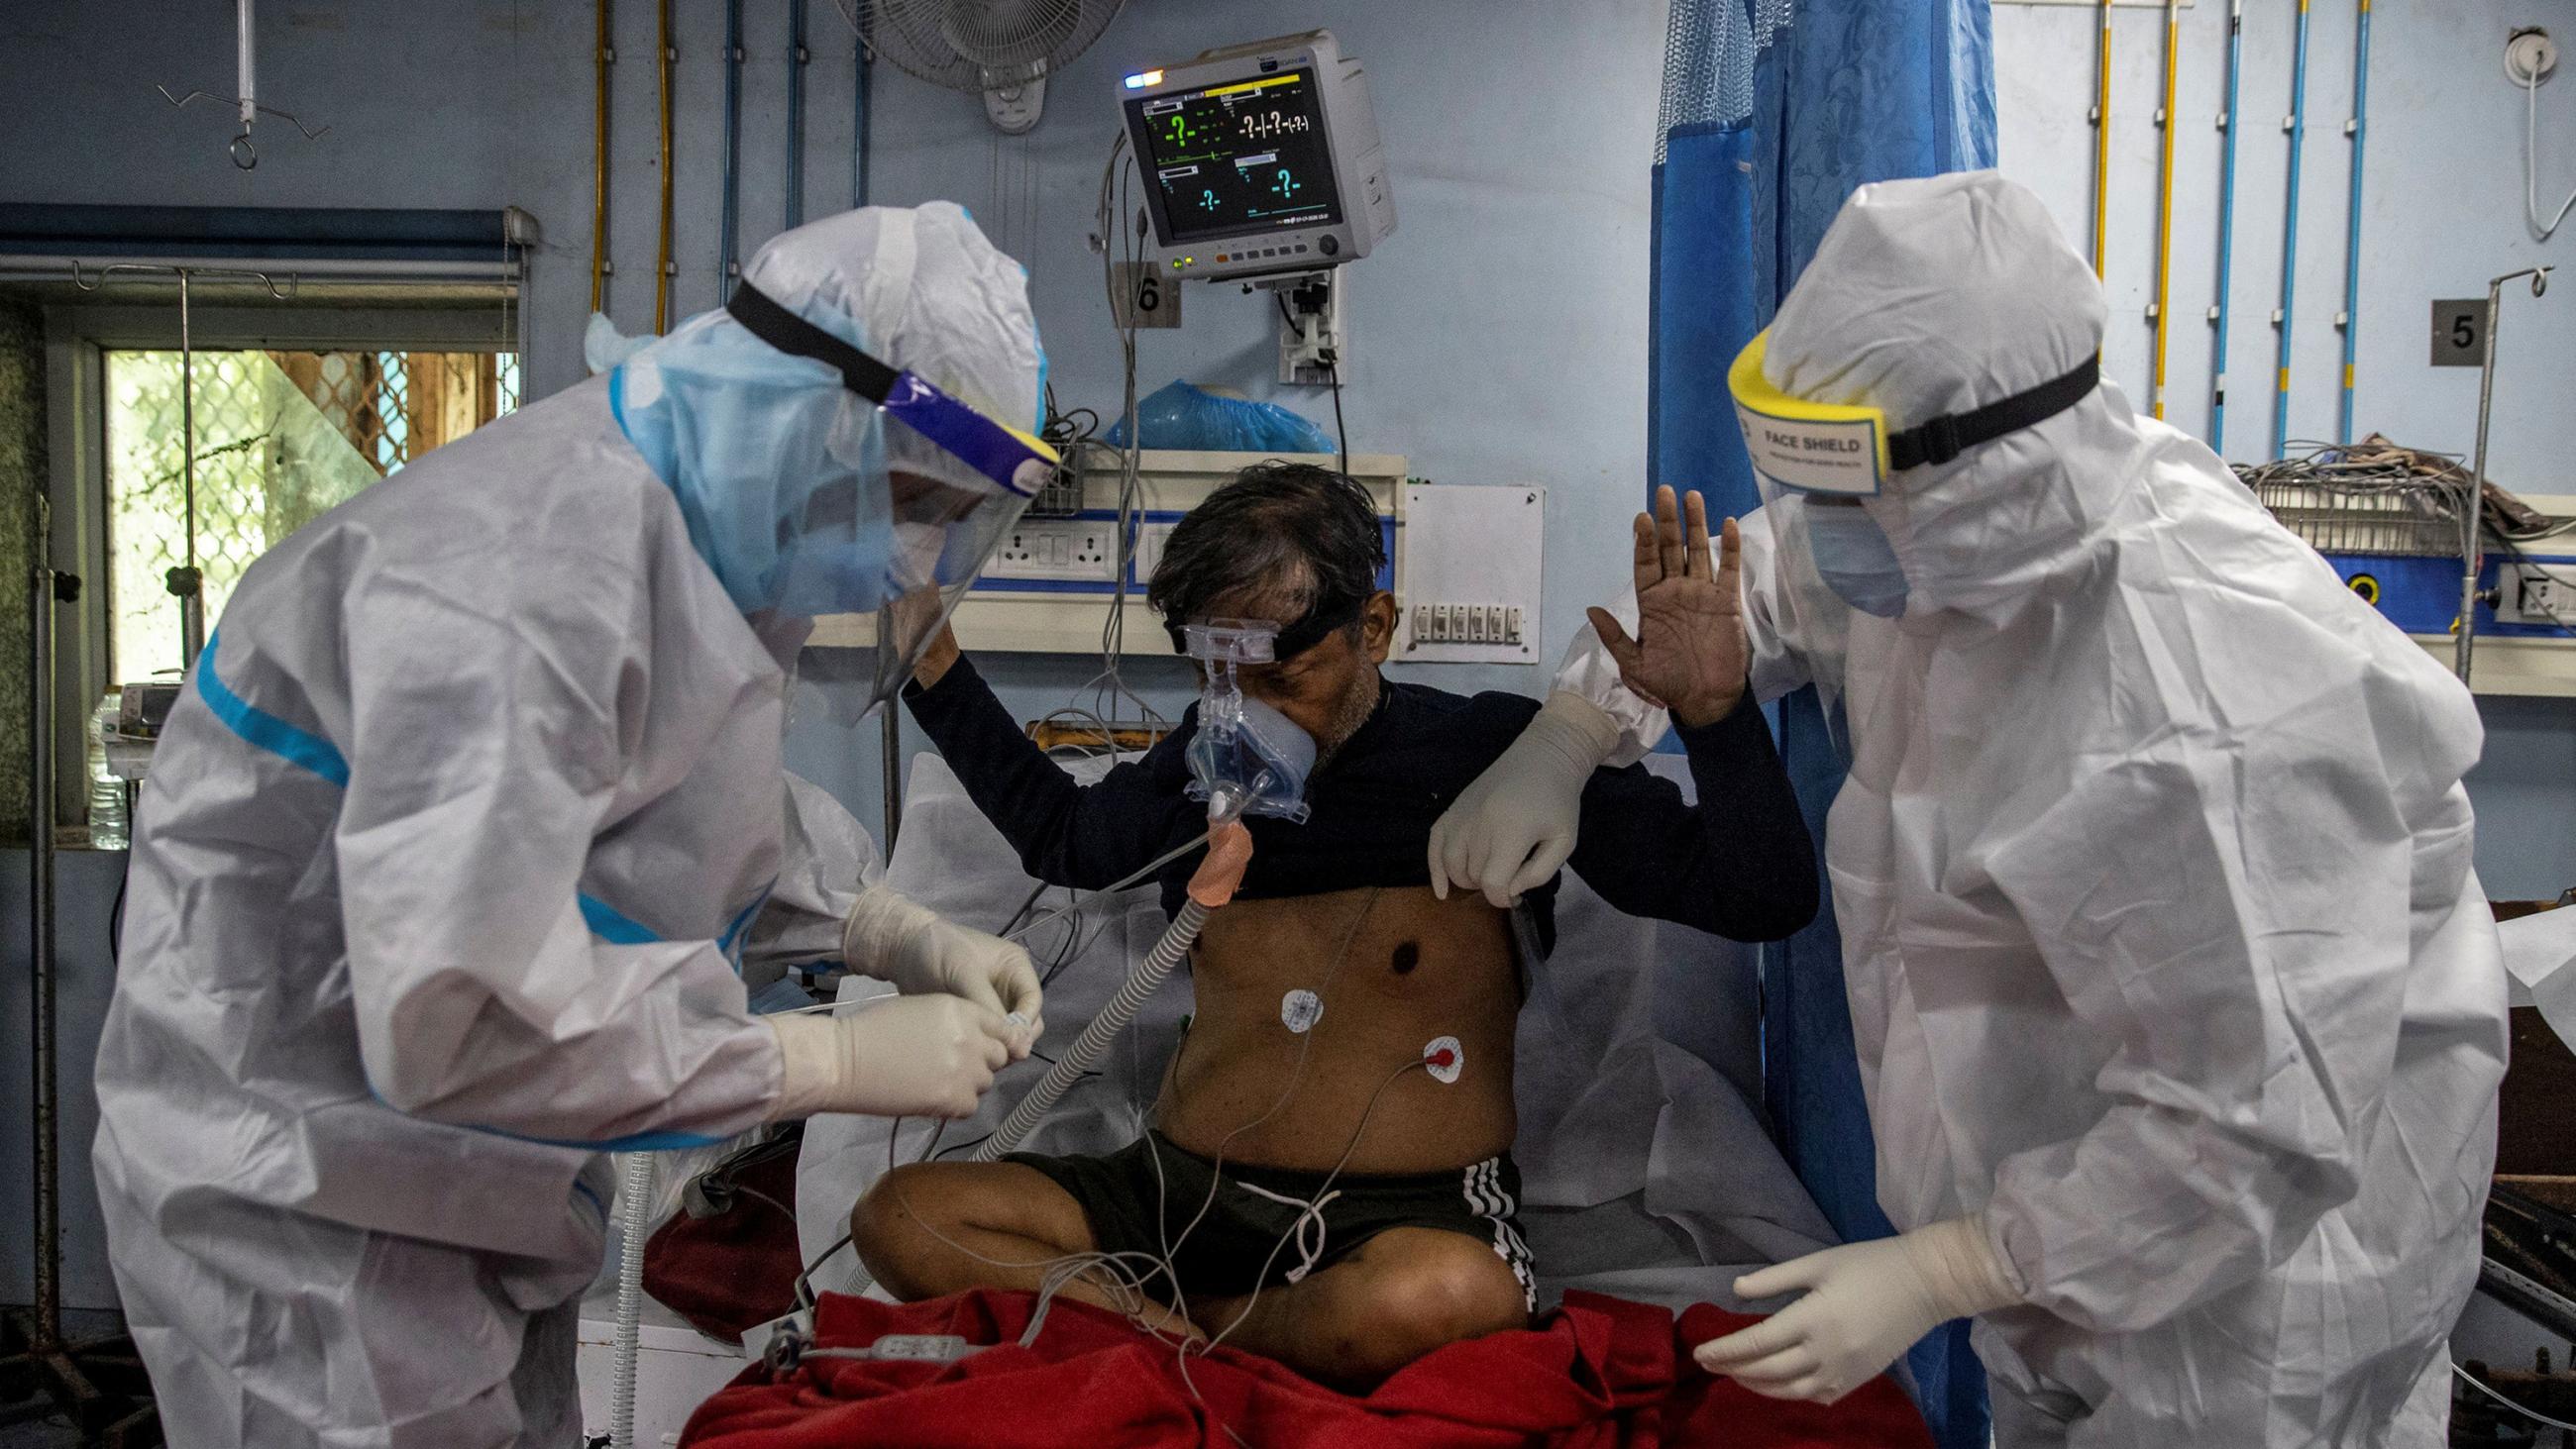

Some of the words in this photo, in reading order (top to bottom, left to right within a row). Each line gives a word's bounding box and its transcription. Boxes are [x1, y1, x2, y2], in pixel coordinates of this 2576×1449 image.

[1138, 277, 1159, 312] 6
[2451, 315, 2474, 349] 5
[1765, 430, 1799, 449] FACE
[1802, 437, 1861, 453] SHIELD
